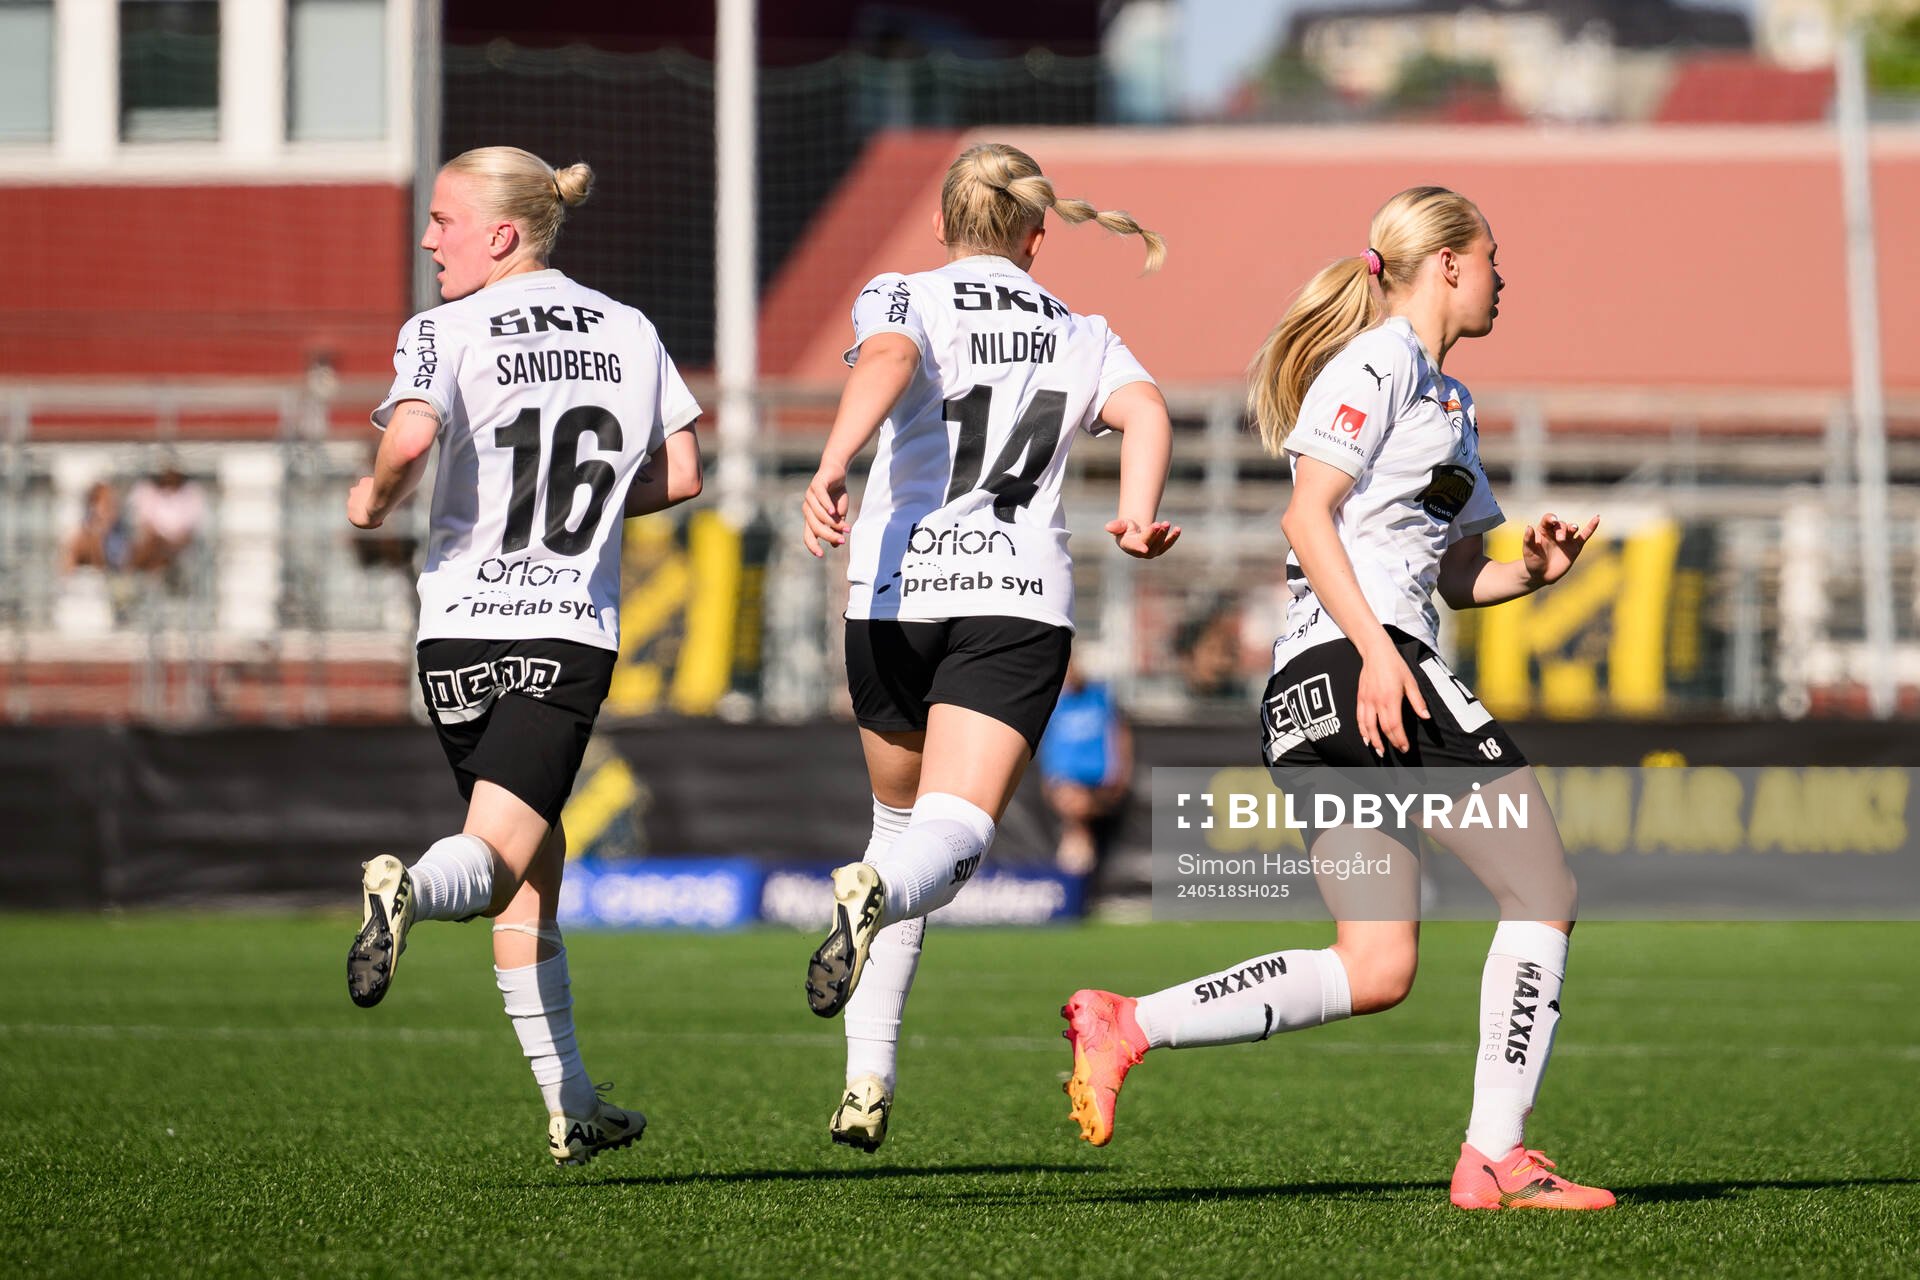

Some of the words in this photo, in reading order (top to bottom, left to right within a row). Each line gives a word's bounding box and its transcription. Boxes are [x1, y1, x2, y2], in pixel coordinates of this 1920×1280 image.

[489, 305, 605, 337] SKF
[413, 319, 438, 390] stadium
[971, 325, 1057, 365] NILDÉN
[497, 349, 622, 386] SANDBERG
[942, 384, 1068, 524] 14
[1314, 428, 1348, 448] SVENSKA
[1349, 443, 1366, 458] SPEL
[494, 405, 624, 557] 16
[903, 571, 994, 597] prefab
[1001, 576, 1043, 596] syd
[470, 598, 553, 618] prefab
[1478, 737, 1503, 760] 18
[1195, 956, 1288, 1004] MAXXIS
[1504, 962, 1542, 1067] MAXXIS
[1485, 1010, 1505, 1062] TYRES
